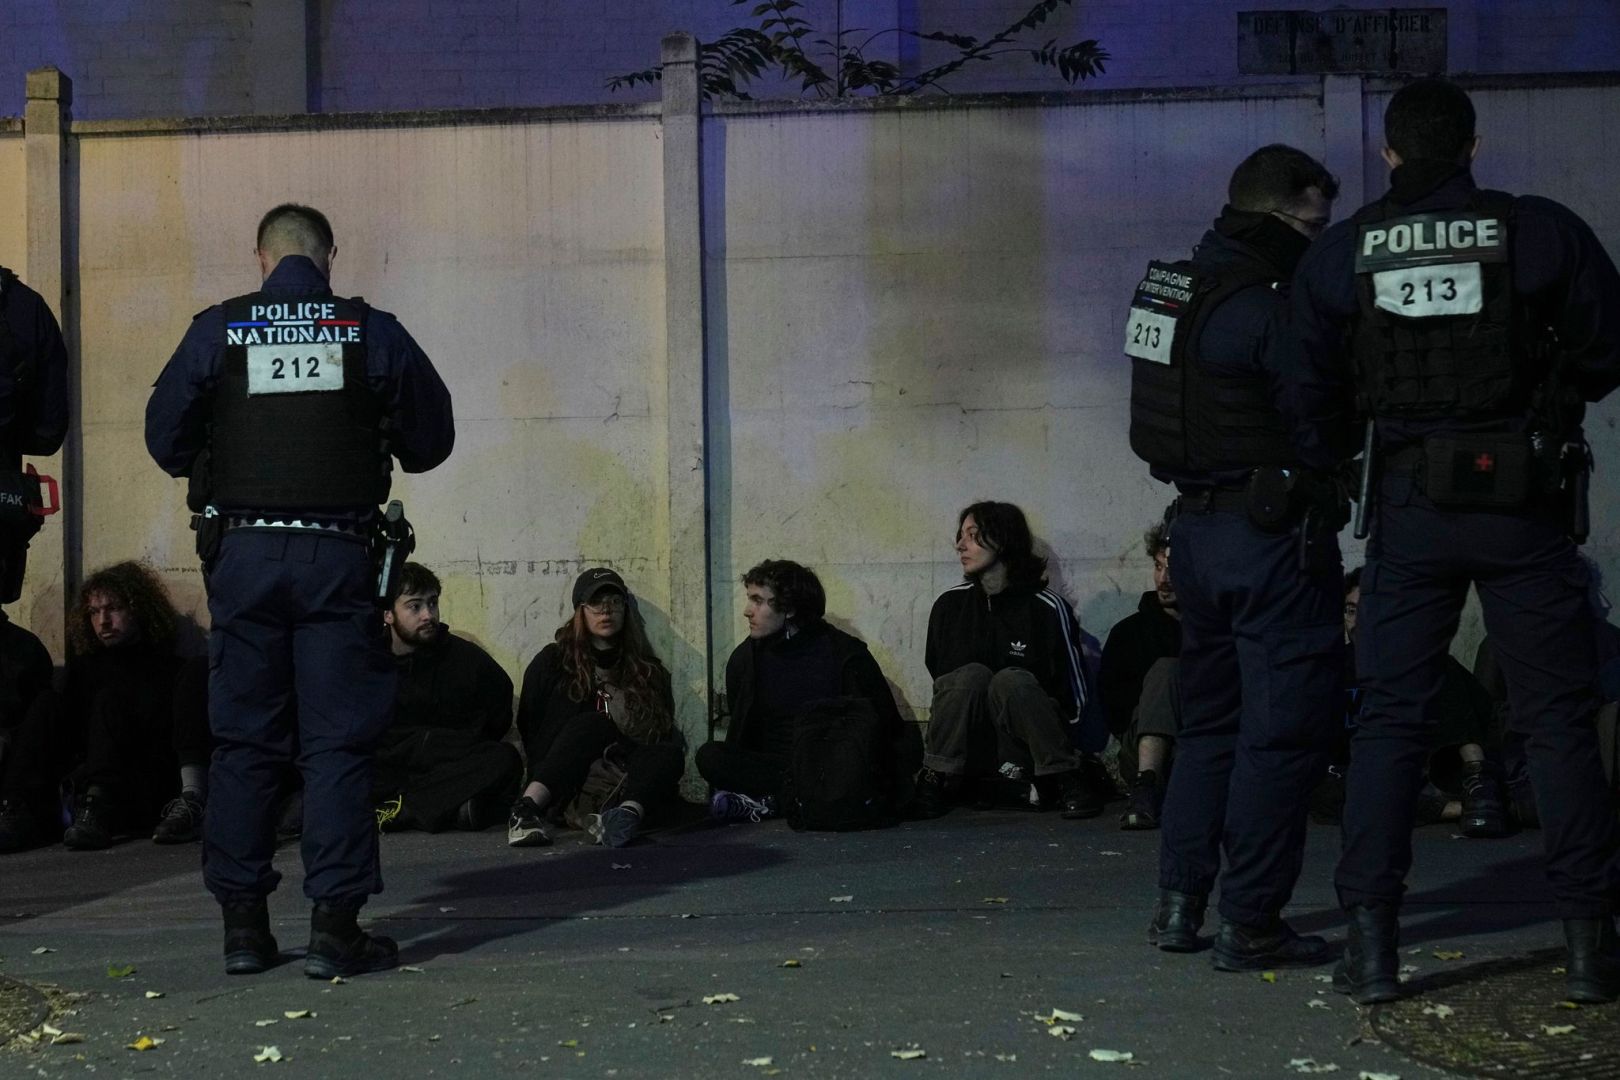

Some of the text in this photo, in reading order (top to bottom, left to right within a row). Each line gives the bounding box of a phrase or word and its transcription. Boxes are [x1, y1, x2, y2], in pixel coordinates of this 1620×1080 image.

[1363, 218, 1500, 256] POLICE
[1149, 266, 1193, 289] COMPAGNIE
[1400, 278, 1457, 305] 213
[251, 303, 335, 321] POLICE
[227, 326, 361, 345] NATIONALE
[1134, 323, 1160, 348] 213
[272, 356, 320, 379] 212
